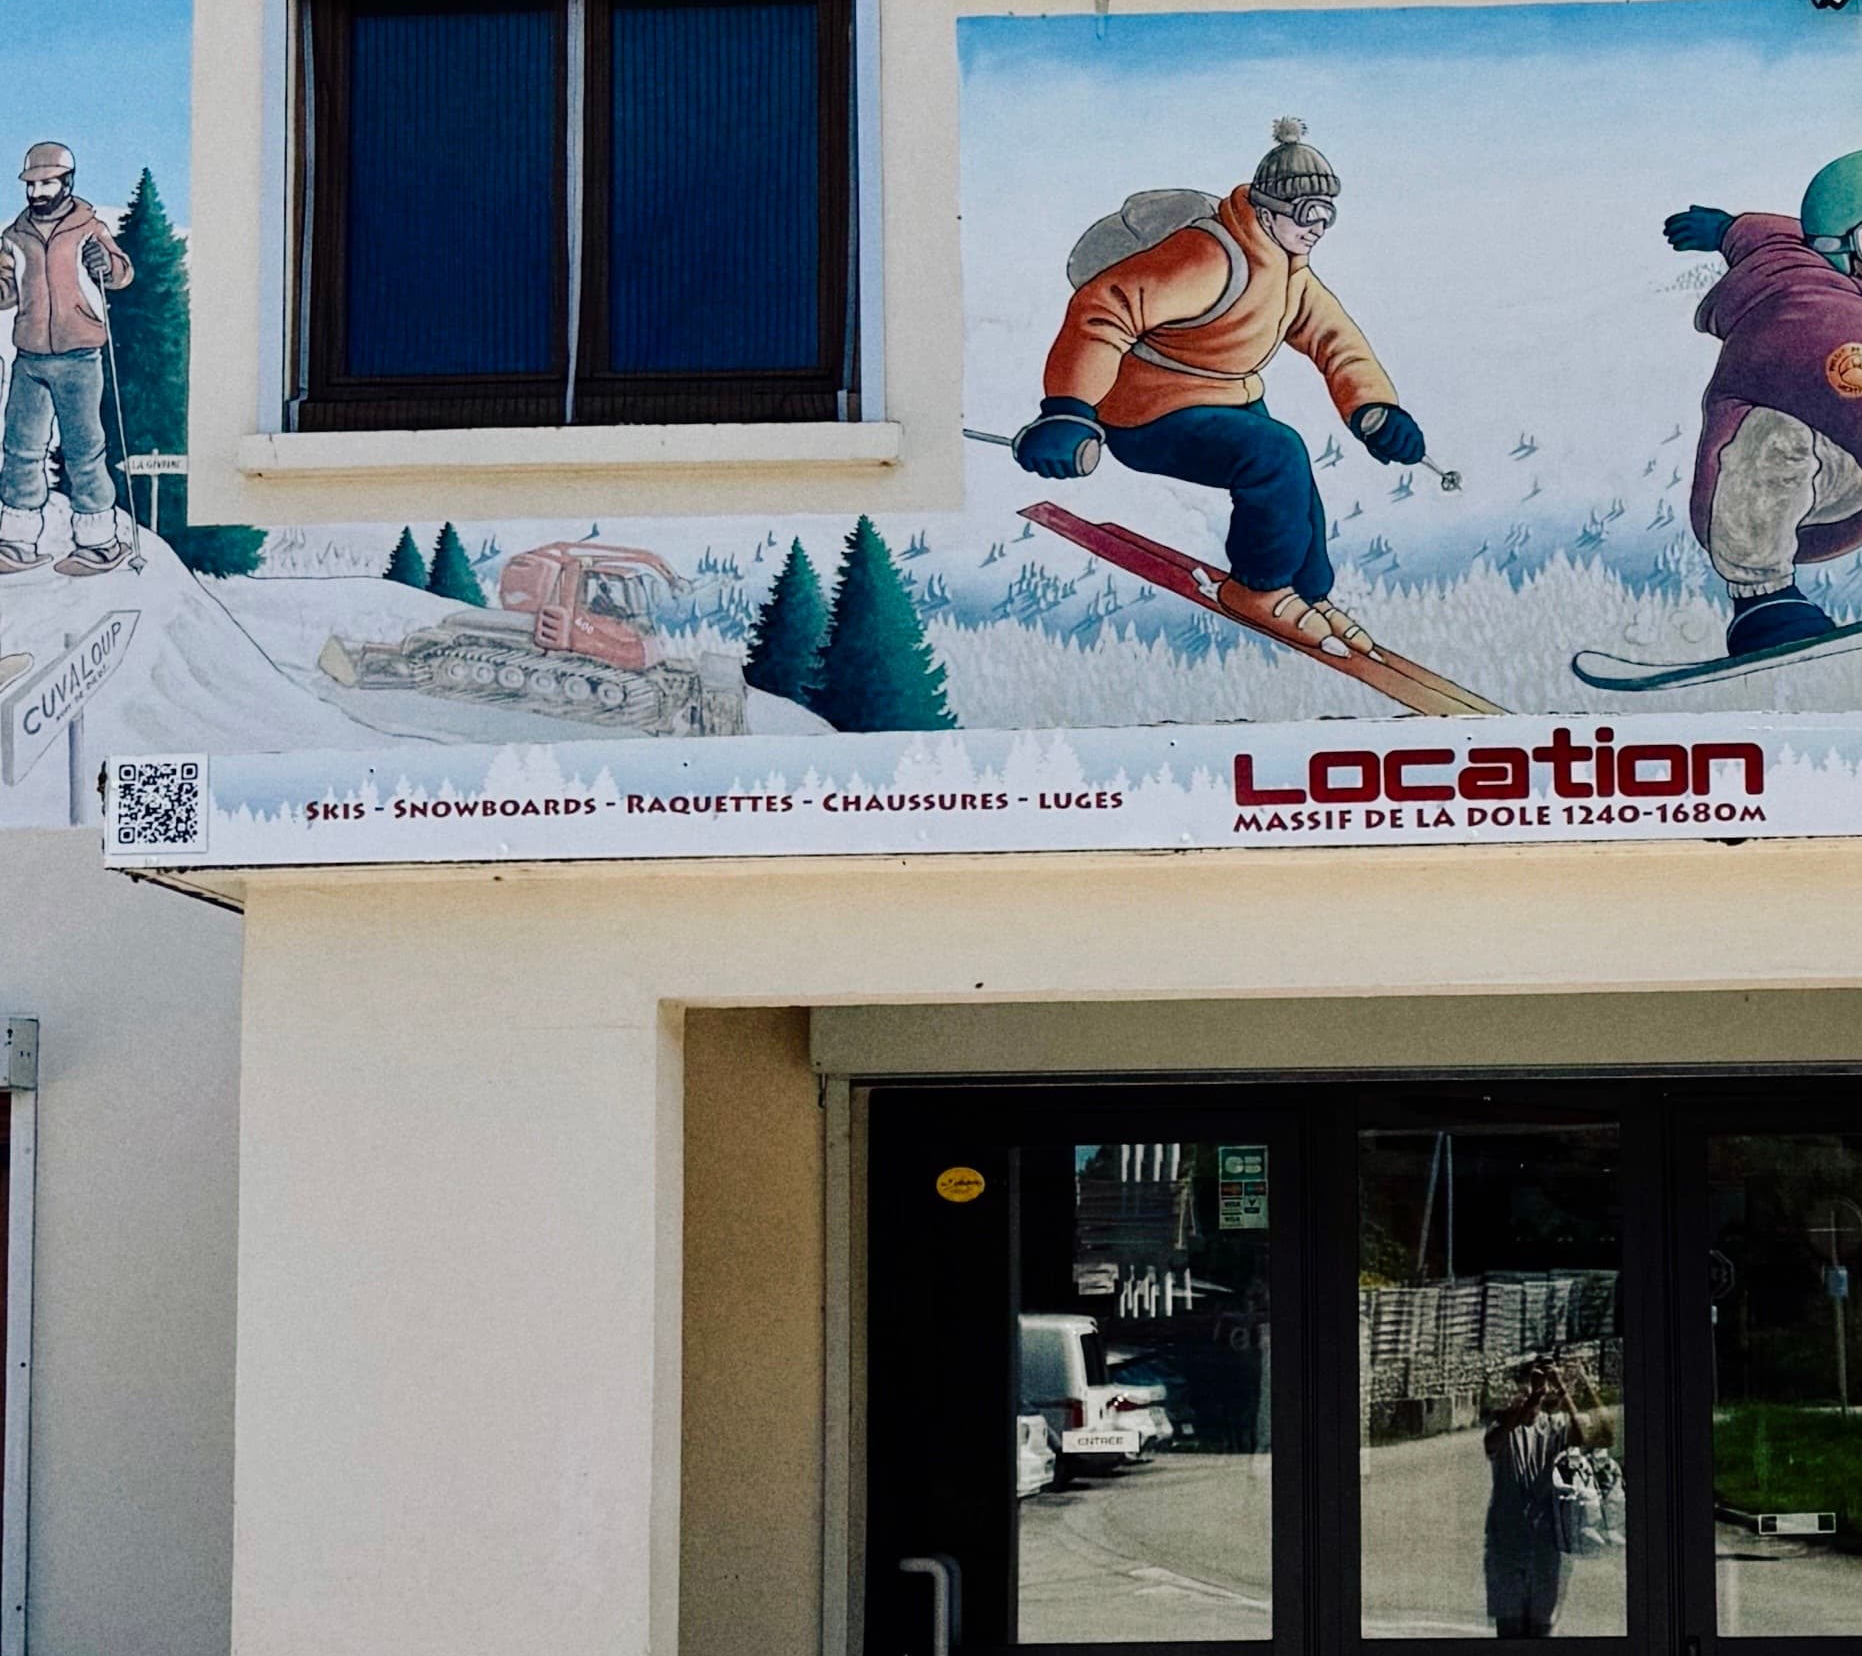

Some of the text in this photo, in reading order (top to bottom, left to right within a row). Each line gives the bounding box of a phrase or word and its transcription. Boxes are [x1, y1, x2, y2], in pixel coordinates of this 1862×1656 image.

[23, 621, 122, 735] CUVALOUP
[1233, 809, 1352, 833] MASSIF
[1364, 808, 1404, 829] DE
[1416, 807, 1456, 828] LA
[1467, 805, 1551, 827] DOLE
